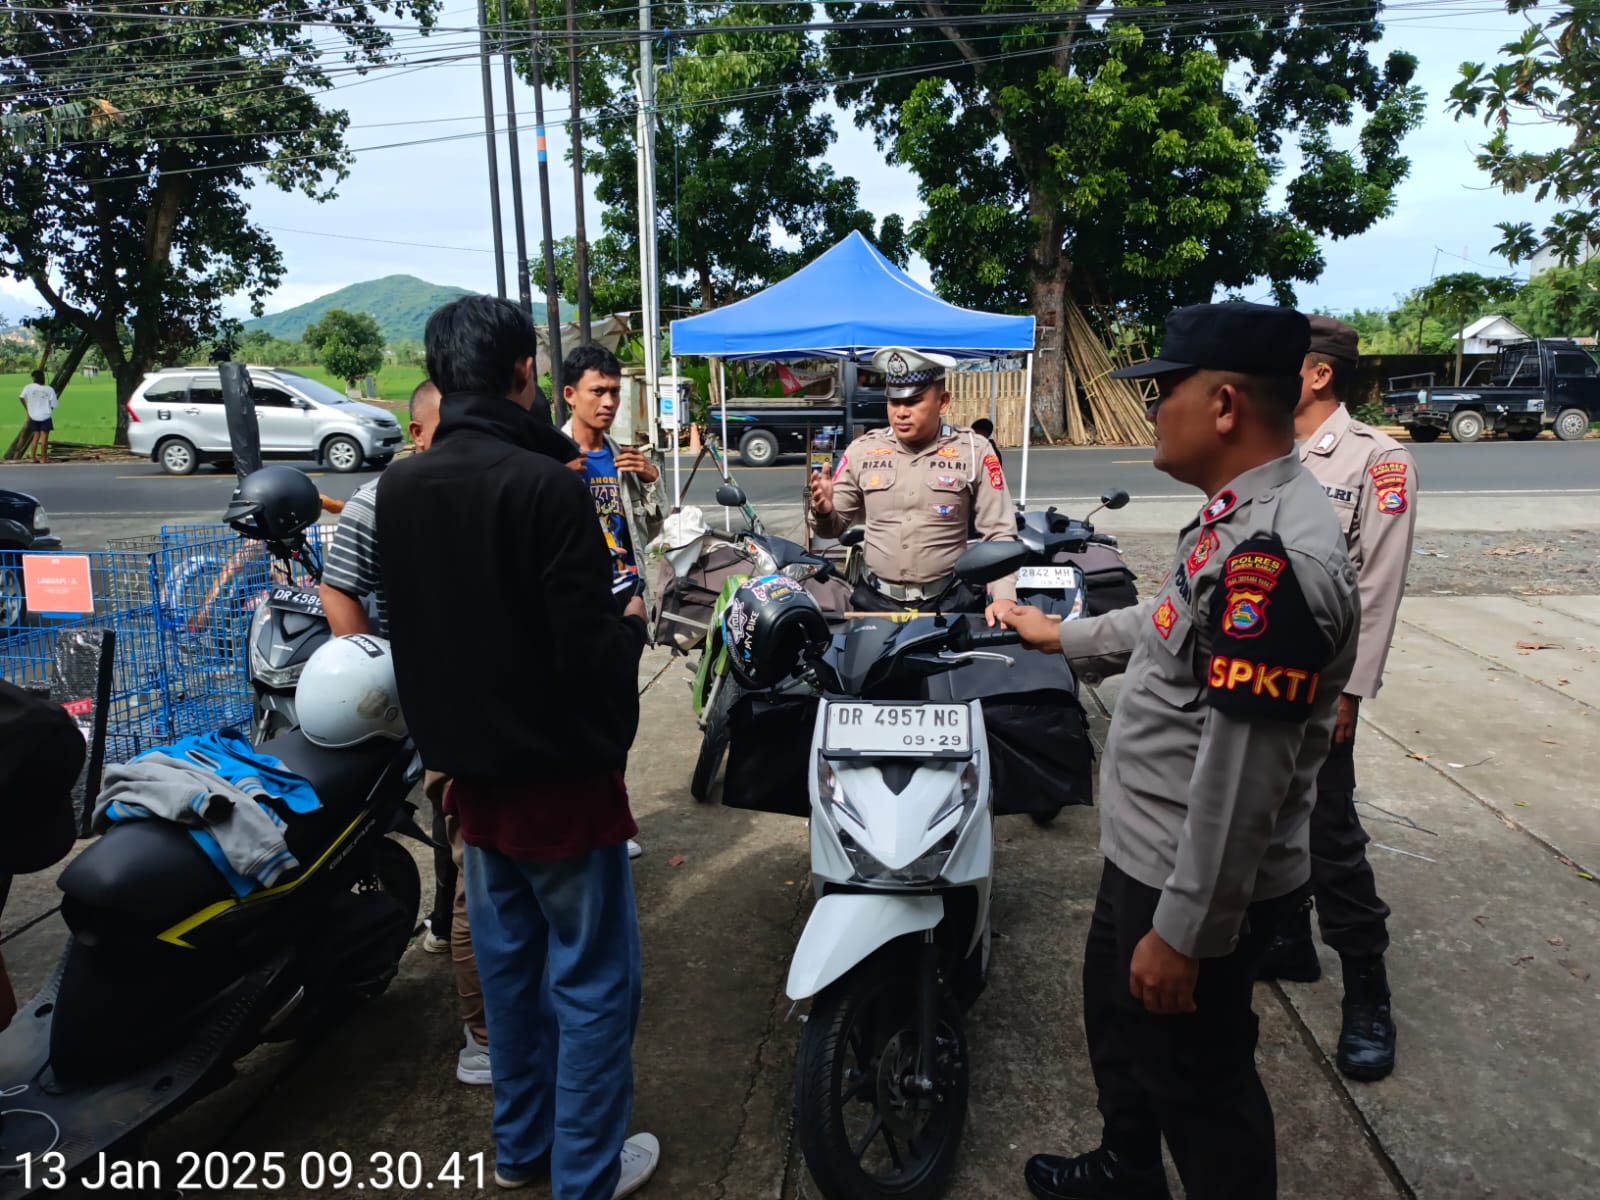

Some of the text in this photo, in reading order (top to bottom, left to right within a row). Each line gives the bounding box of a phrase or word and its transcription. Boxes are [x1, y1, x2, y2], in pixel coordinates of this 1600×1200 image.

[862, 460, 893, 470] RIZAL
[930, 461, 967, 471] POLRI
[1230, 555, 1281, 570] POLRES
[274, 589, 292, 600] DR
[745, 610, 760, 632] BIKE
[743, 632, 753, 650] MY
[838, 708, 959, 727] DR 4957 NG
